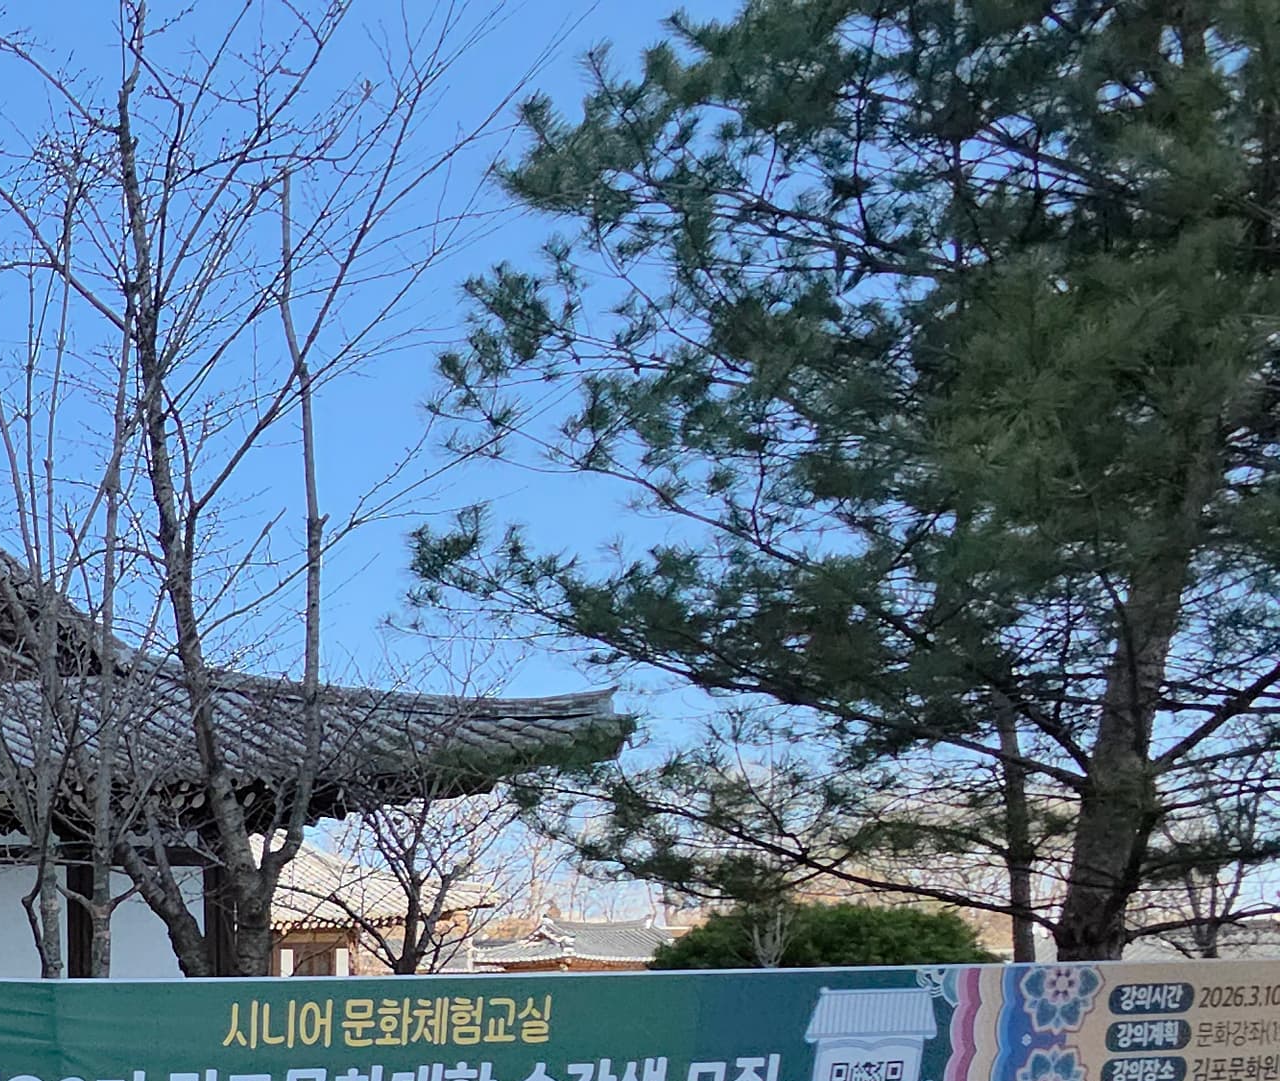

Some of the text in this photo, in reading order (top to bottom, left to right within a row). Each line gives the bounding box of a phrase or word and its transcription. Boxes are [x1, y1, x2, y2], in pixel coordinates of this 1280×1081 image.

[1120, 984, 1184, 1011] 강의시간
[223, 995, 552, 1048] 시니어 문화체험교실
[1116, 1020, 1180, 1048] 강의계획
